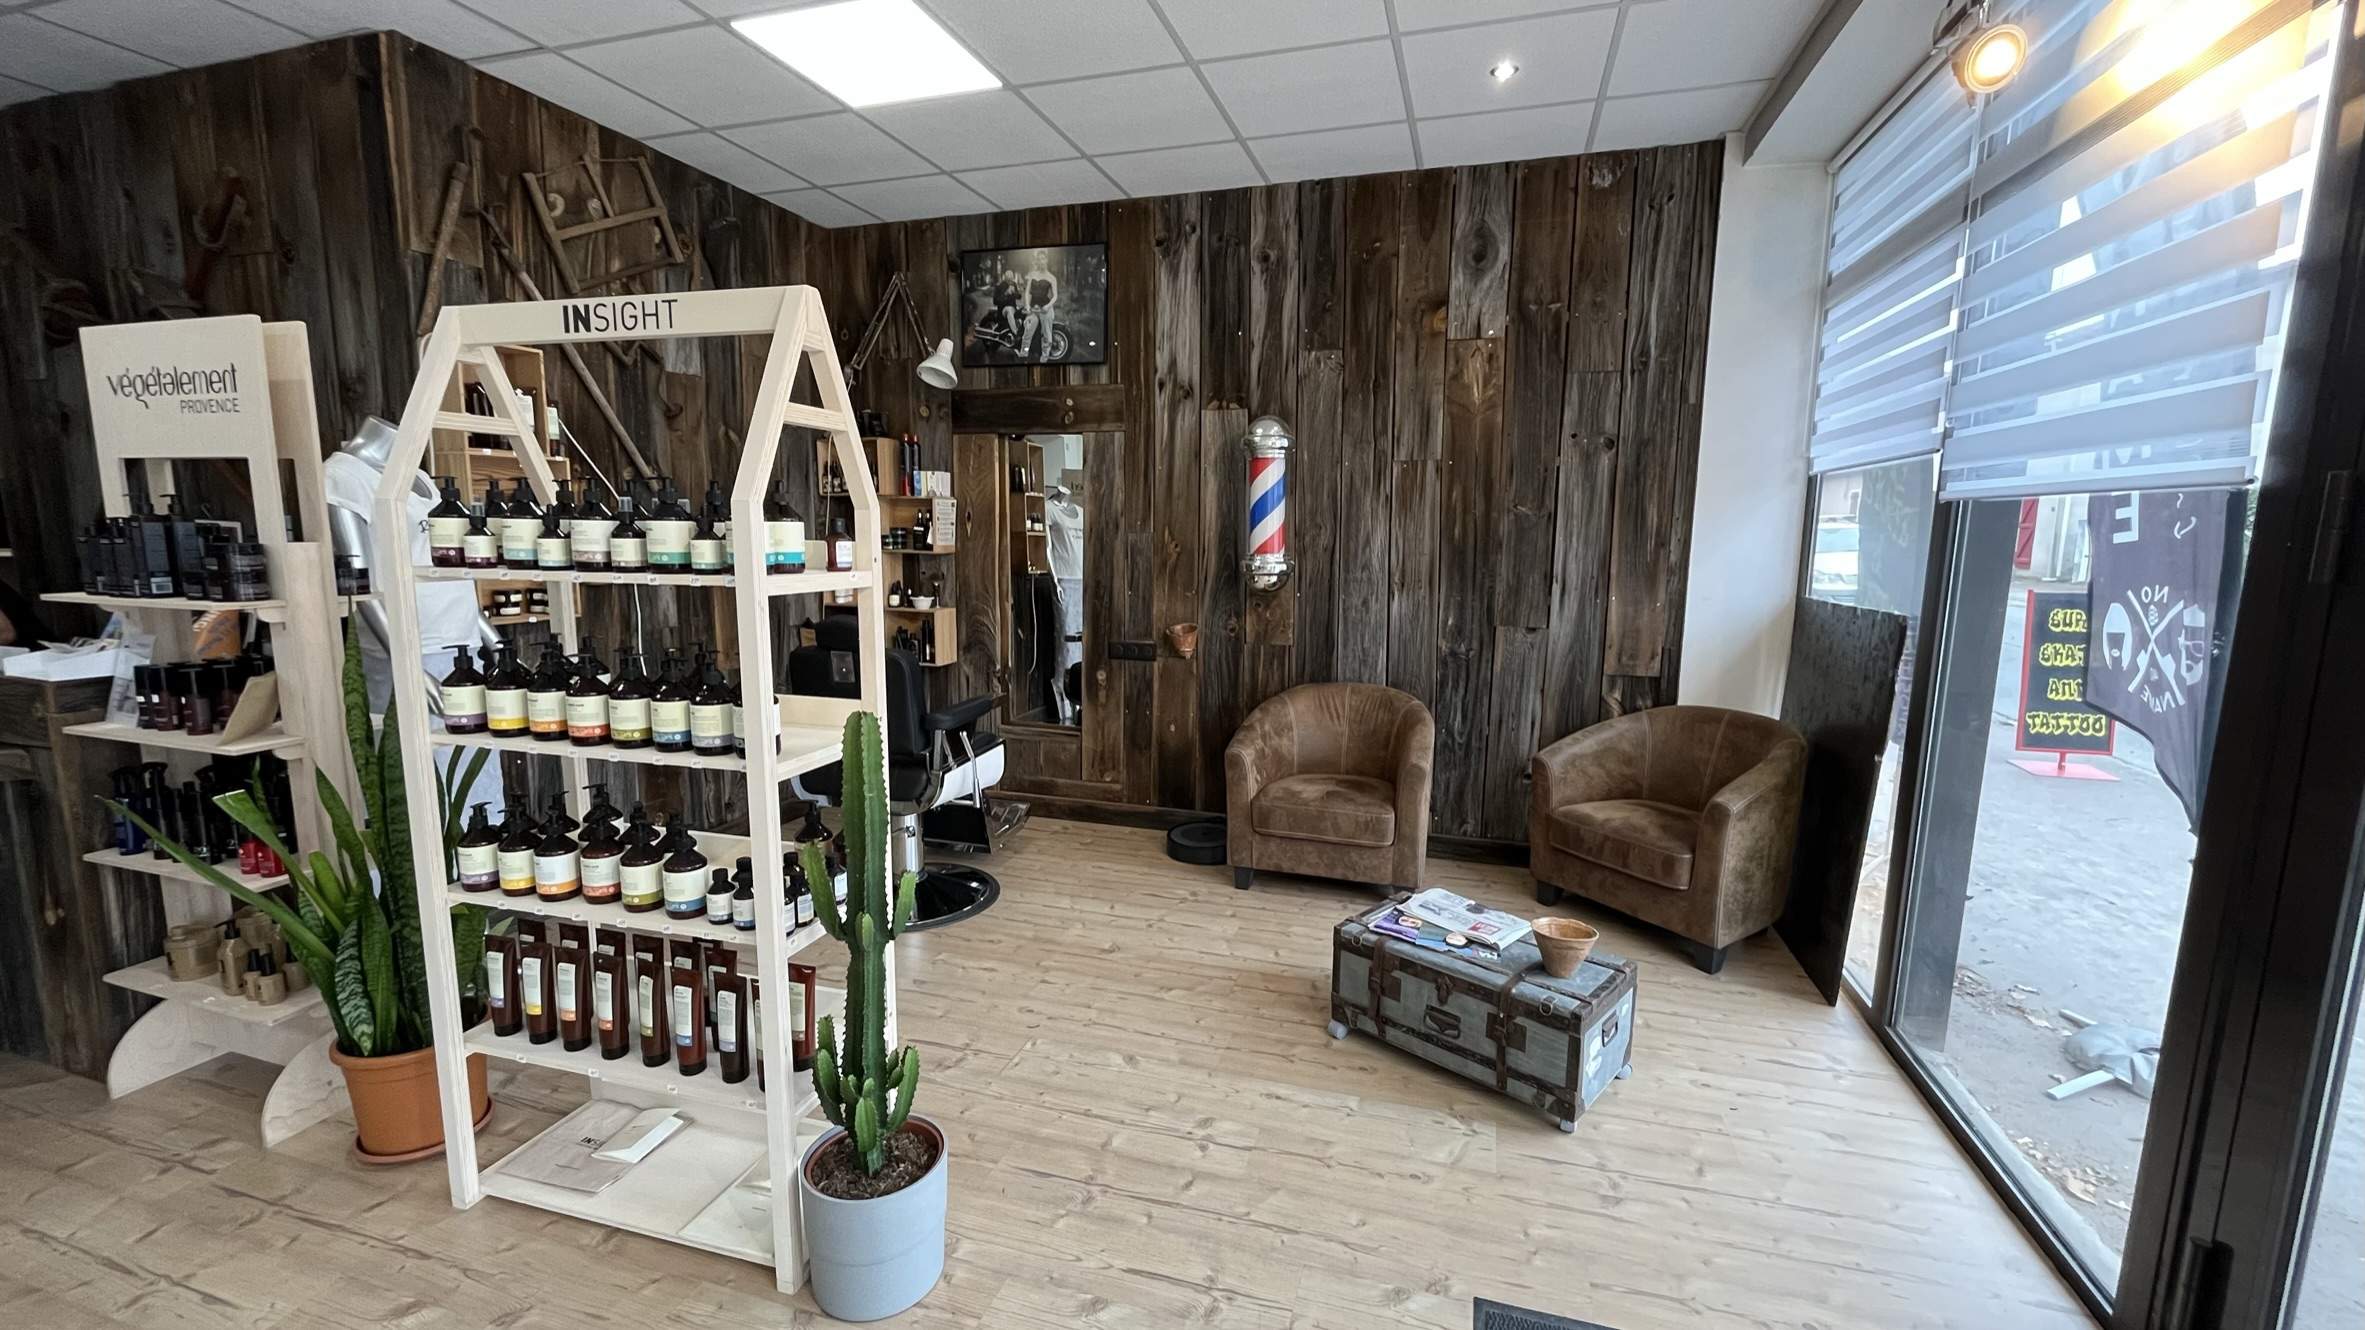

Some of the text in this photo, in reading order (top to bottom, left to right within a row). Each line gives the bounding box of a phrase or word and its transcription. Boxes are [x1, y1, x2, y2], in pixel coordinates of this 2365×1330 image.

[562, 298, 678, 334] INSIGHT
[106, 362, 238, 410] végétalement
[180, 397, 241, 414] PROVENCE
[2026, 712, 2106, 736] TATTOO
